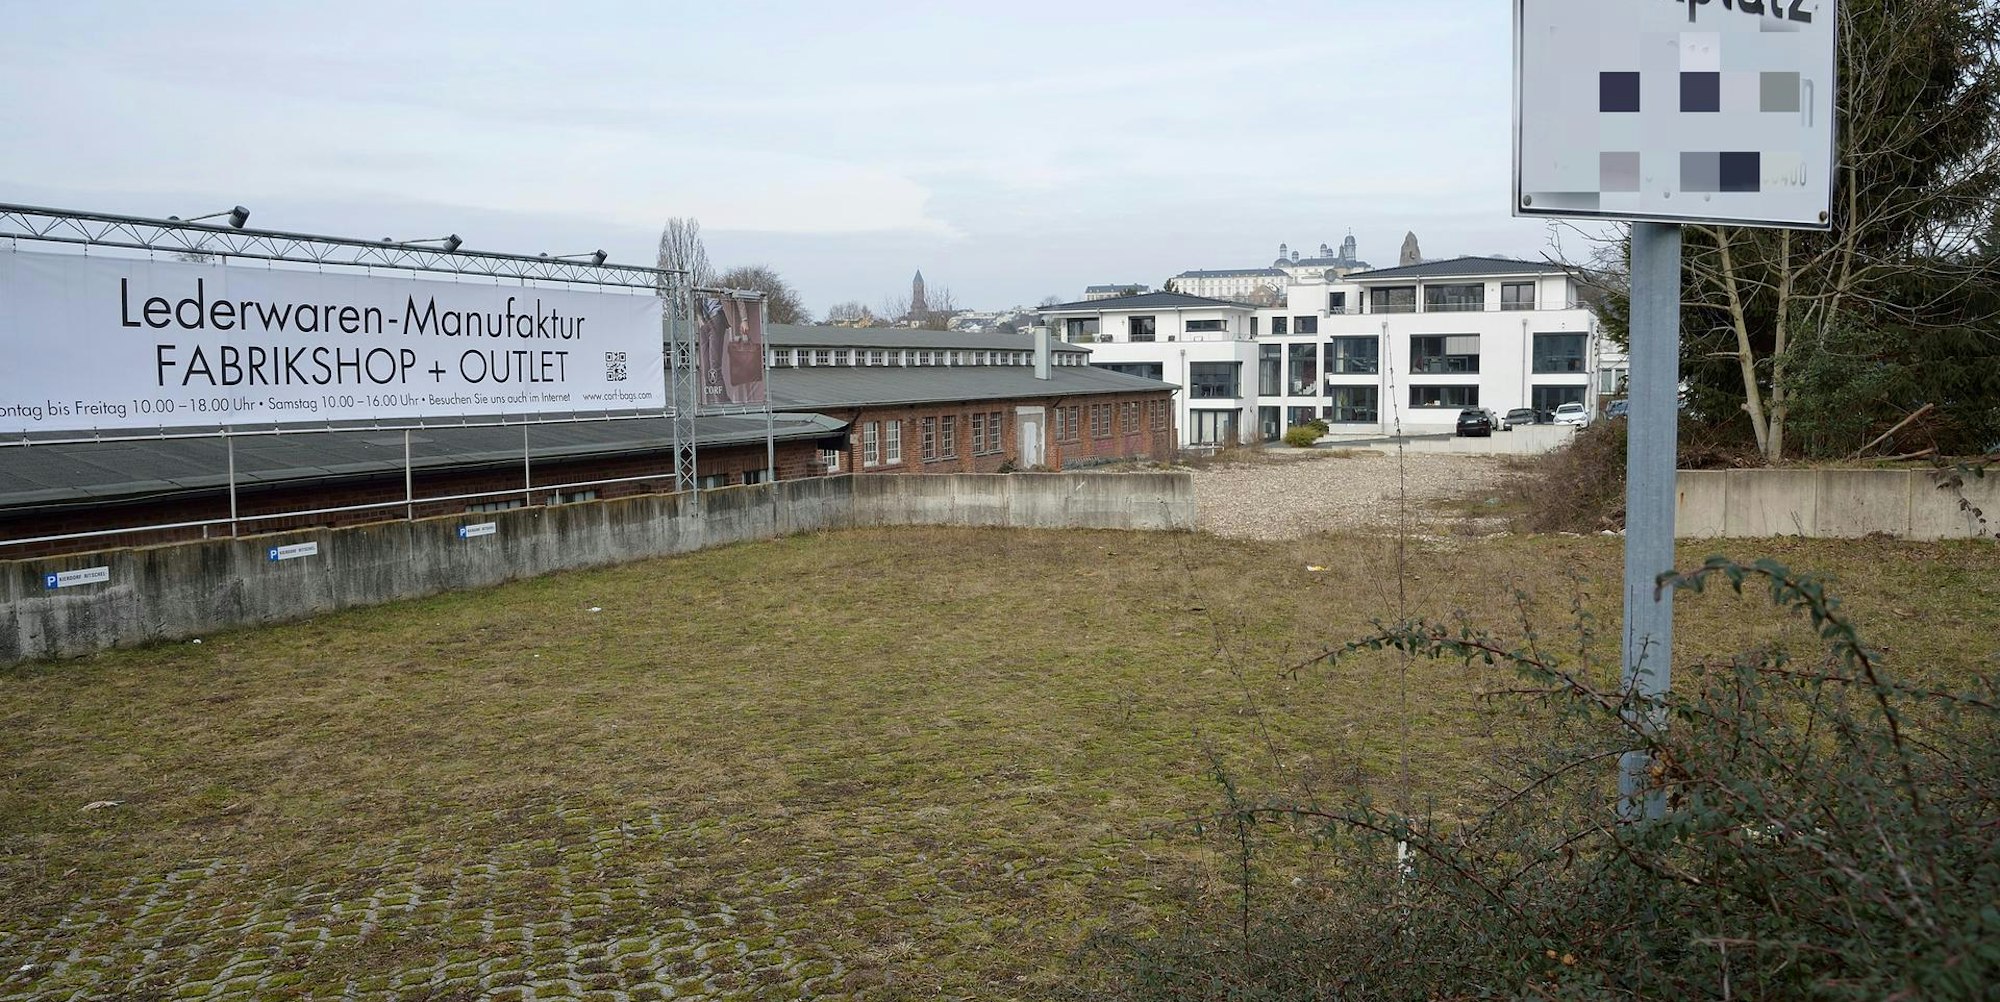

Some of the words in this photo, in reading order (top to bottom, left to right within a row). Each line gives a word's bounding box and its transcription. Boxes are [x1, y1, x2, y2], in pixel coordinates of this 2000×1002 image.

[121, 277, 585, 340] Lederwaren-Manufaktur
[157, 344, 416, 386] FABRIKSHOP
[428, 361, 446, 382] +
[460, 349, 569, 384] OUTLET
[0, 403, 42, 421] ontag
[47, 399, 70, 416] bis
[75, 400, 127, 419] Freitag
[133, 398, 175, 414] 10.00
[233, 395, 256, 411] Uhr
[268, 396, 318, 413] Samstag
[322, 394, 354, 408] 10.00
[400, 392, 419, 406] Uhr
[429, 392, 472, 405] Besuchen
[474, 392, 488, 404] Sie
[491, 393, 506, 404] uns
[508, 390, 528, 403] auch
[529, 391, 540, 403] im
[541, 391, 571, 403] Internet
